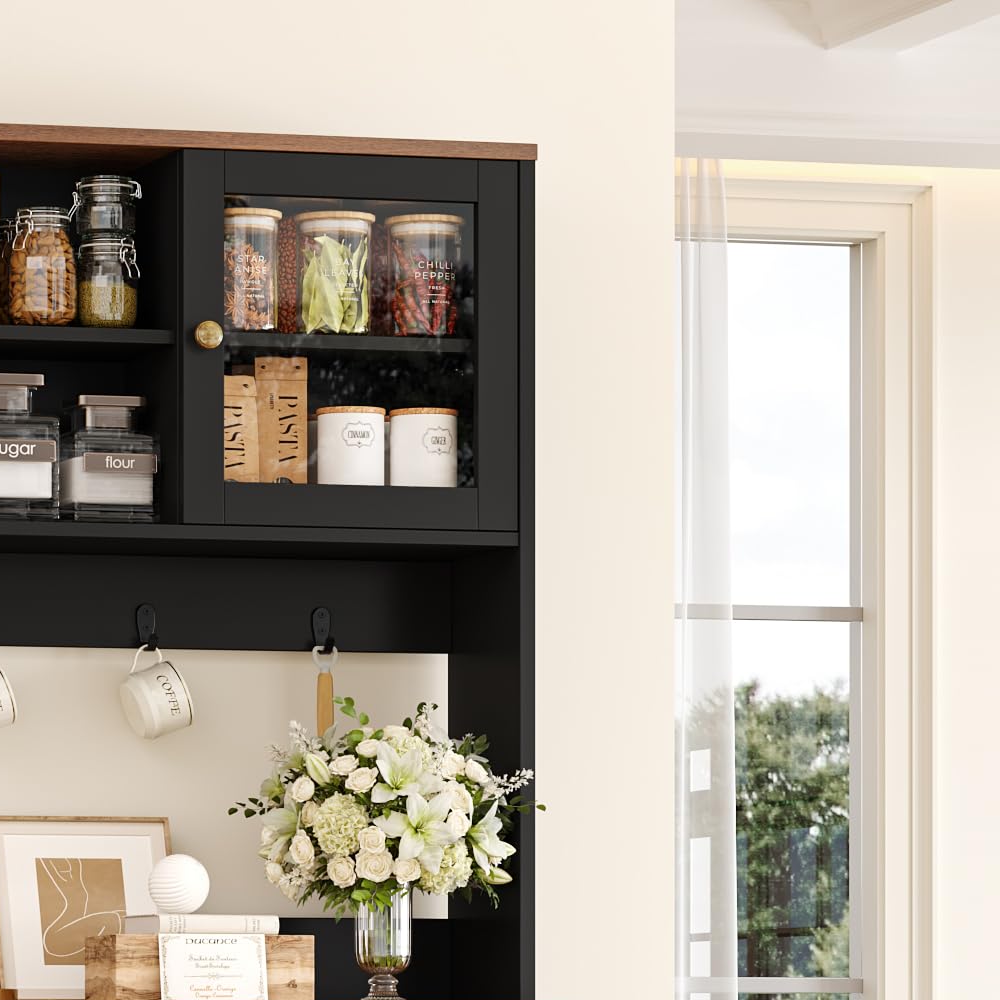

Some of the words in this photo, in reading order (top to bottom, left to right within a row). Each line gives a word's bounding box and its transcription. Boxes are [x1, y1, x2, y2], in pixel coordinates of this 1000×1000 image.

[237, 254, 266, 263] STAR
[235, 264, 267, 274] ANISE
[418, 261, 453, 269] CHILLI
[415, 271, 455, 280] PEPPER
[279, 396, 298, 462] PASTA
[224, 405, 245, 468] PASTA
[105, 456, 136, 469] flour
